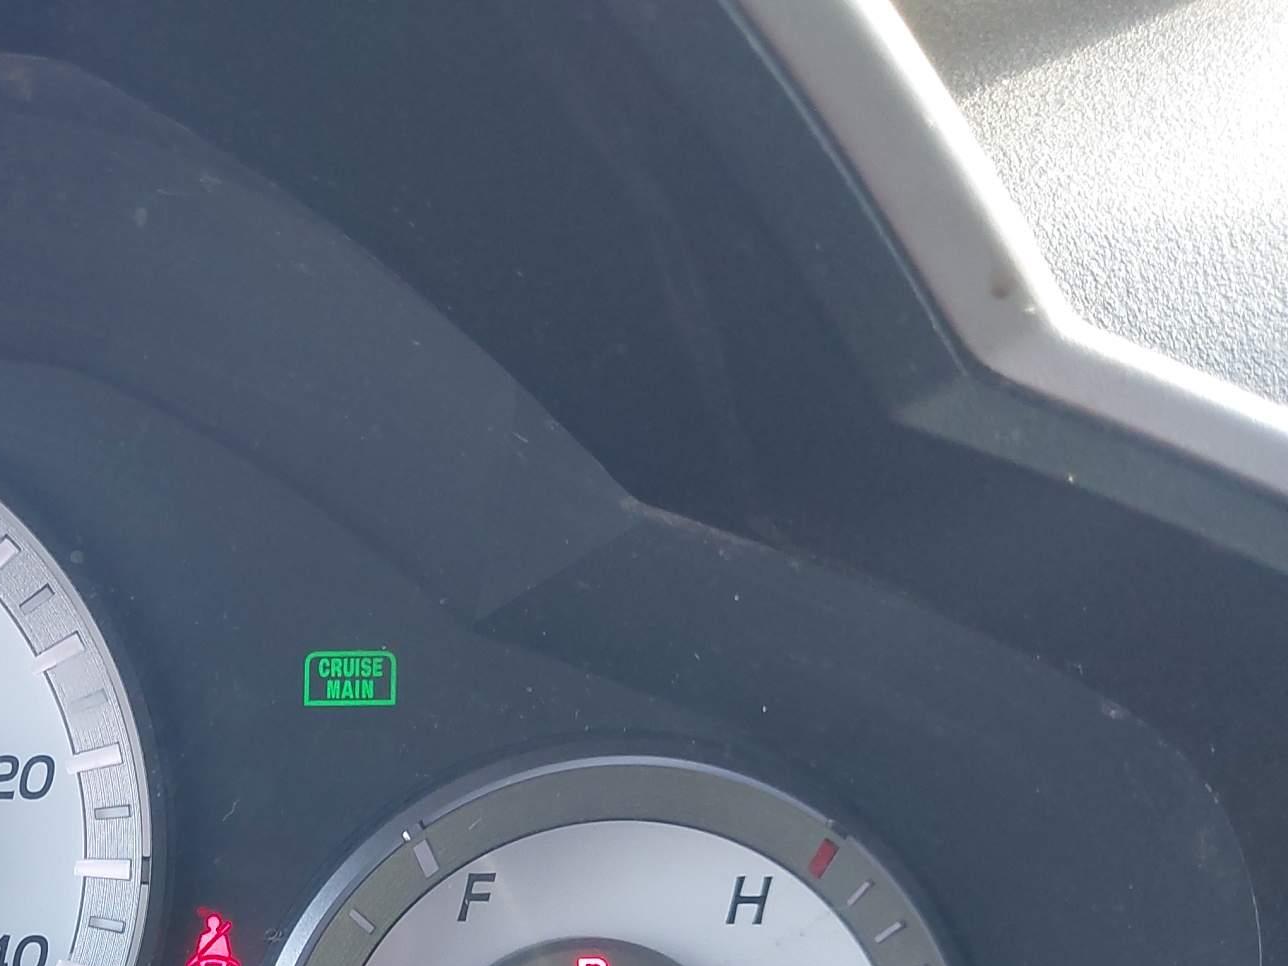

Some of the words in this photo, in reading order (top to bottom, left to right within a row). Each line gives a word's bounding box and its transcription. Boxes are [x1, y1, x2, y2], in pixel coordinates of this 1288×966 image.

[318, 658, 384, 678] CRUISE
[327, 679, 374, 699] MAIN
[456, 872, 497, 922] F
[726, 876, 773, 925] H
